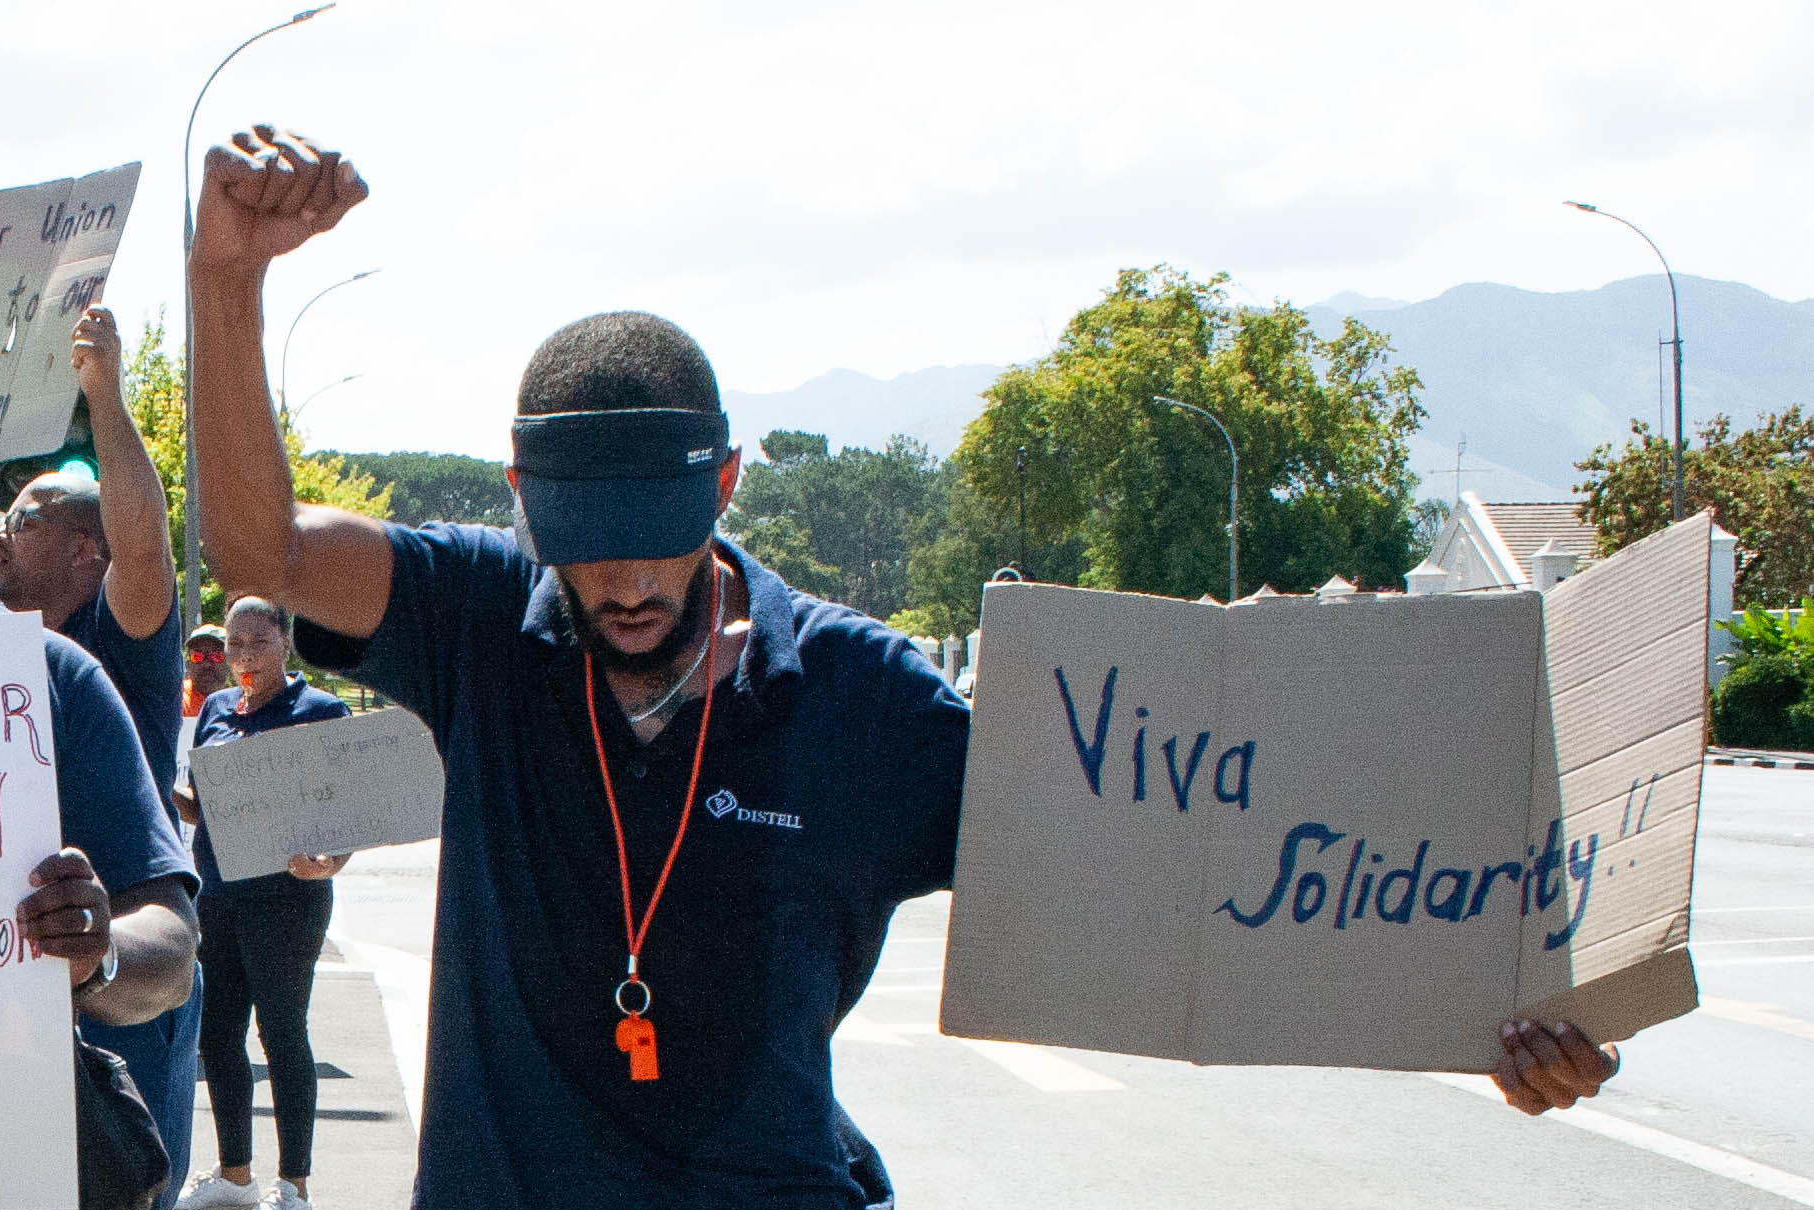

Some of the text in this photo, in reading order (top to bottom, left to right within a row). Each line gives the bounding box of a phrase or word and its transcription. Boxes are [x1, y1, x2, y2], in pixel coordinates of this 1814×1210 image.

[41, 201, 115, 244] Union
[1053, 665, 1257, 813] Viva
[737, 808, 803, 828] DISTELL
